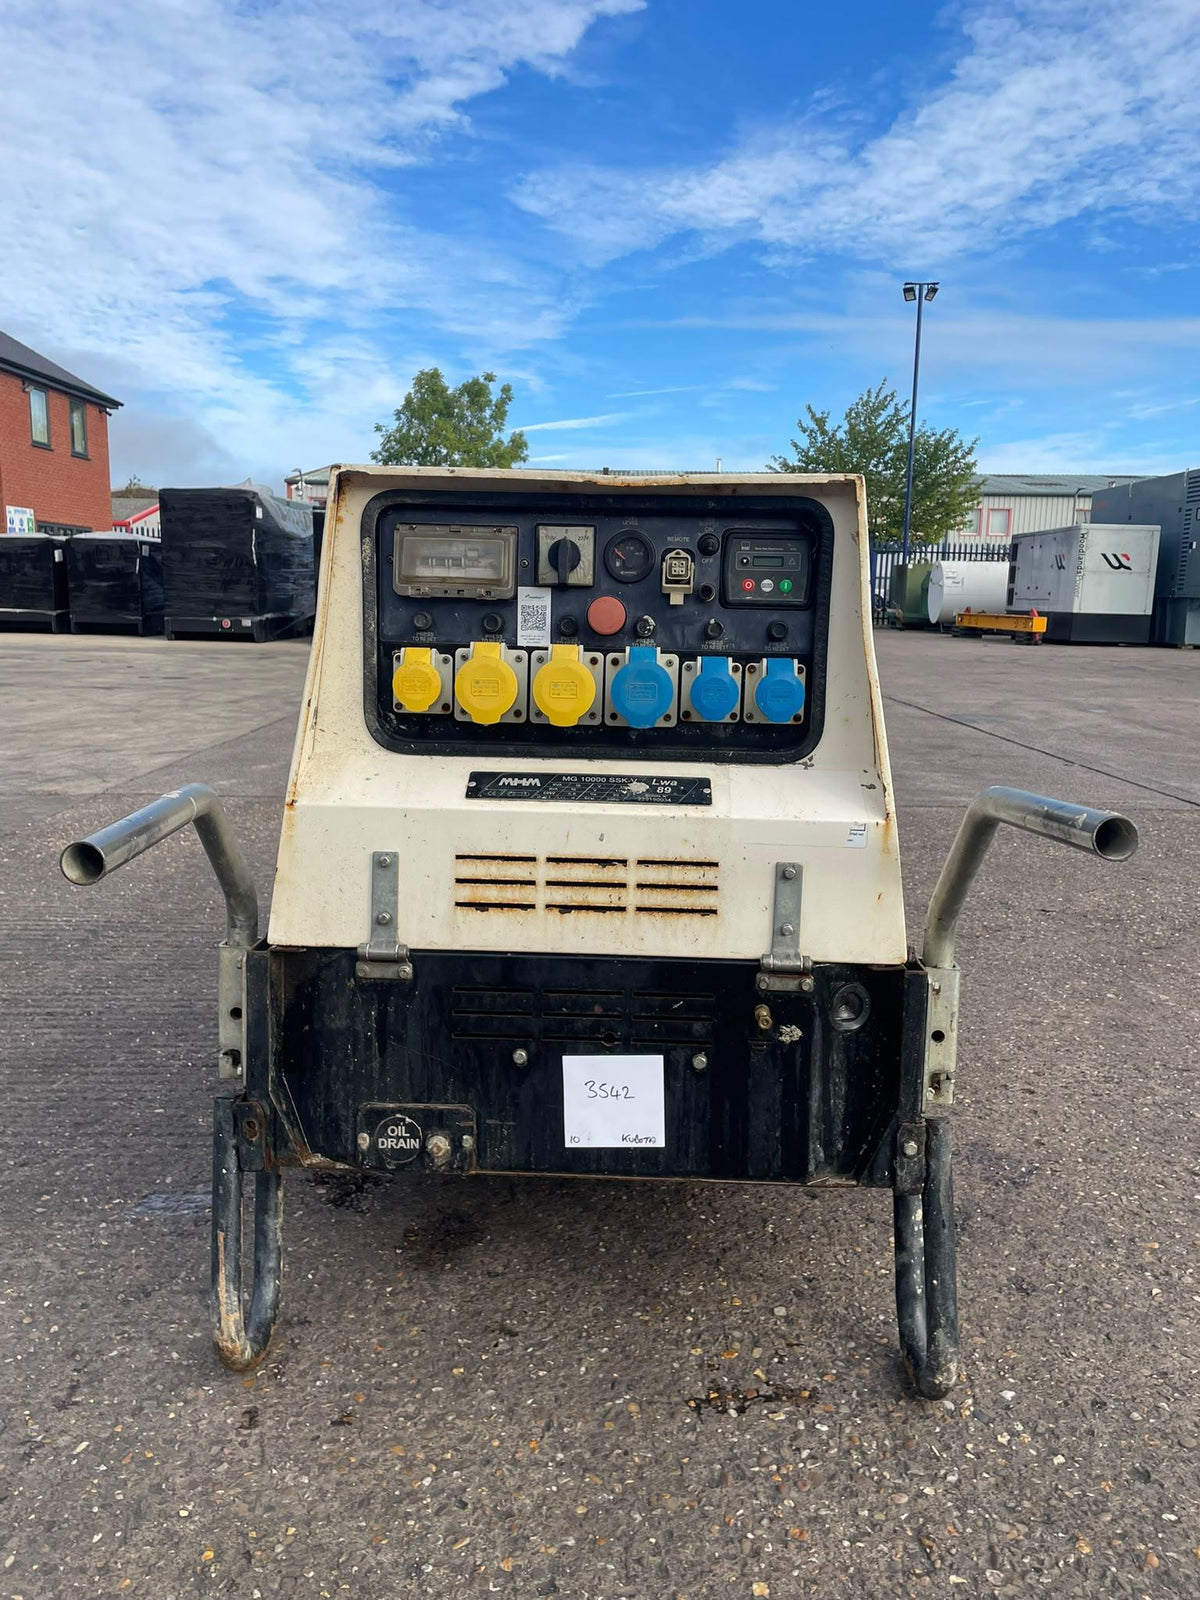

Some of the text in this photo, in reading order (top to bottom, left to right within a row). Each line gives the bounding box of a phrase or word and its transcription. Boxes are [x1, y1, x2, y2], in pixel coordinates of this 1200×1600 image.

[656, 786, 672, 794] 89
[584, 1080, 635, 1100] 3542
[387, 1126, 410, 1137] OIL
[378, 1138, 420, 1150] DRAIN
[570, 1135, 581, 1144] 10
